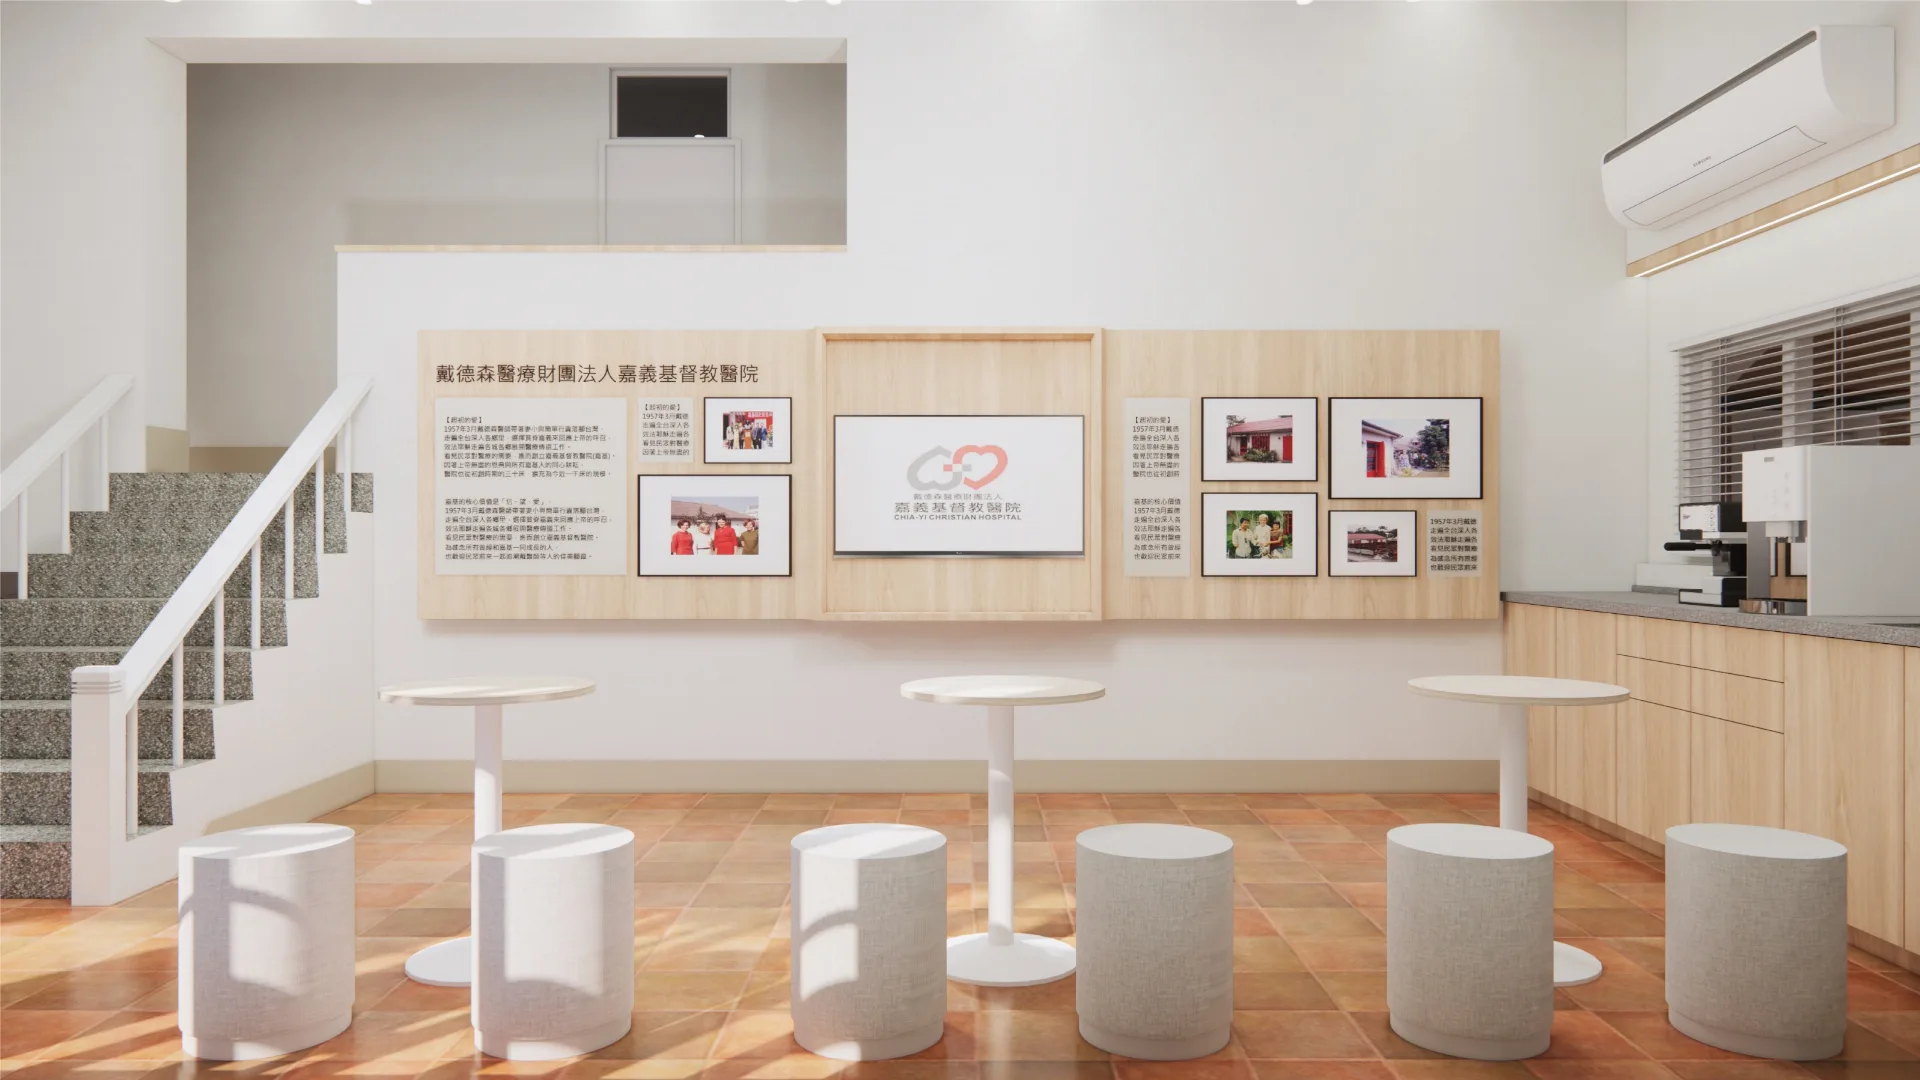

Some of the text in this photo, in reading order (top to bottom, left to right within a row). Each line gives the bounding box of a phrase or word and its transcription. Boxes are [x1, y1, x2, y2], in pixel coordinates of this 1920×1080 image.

[436, 364, 759, 384] 戴德森醫療財團法人嘉義基督教醫院
[894, 502, 1022, 514] 嘉義基督教醫院
